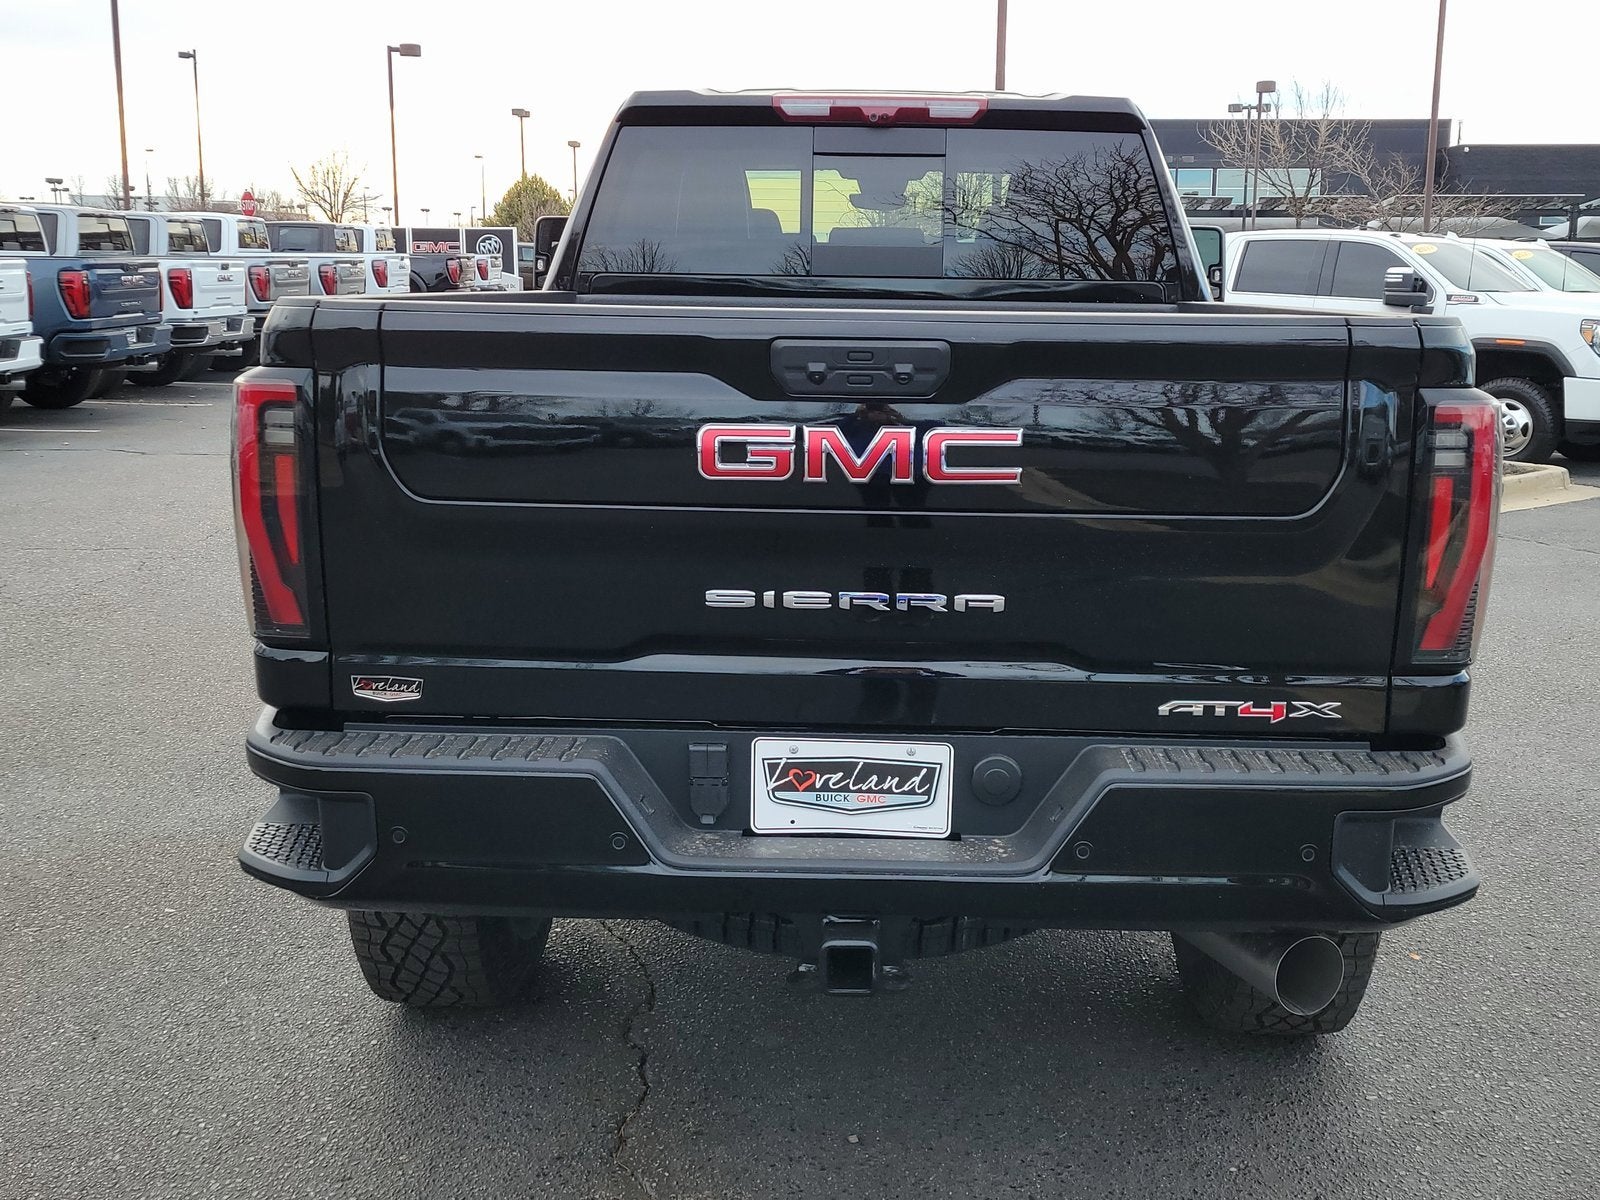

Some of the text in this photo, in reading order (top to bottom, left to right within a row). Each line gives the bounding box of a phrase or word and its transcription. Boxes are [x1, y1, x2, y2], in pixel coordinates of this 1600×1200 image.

[241, 200, 255, 211] STOP
[412, 241, 460, 254] GMC
[696, 423, 1024, 486] GMC
[704, 589, 1006, 614] SIERRA
[1157, 700, 1342, 724] AT4X
[815, 793, 887, 804] BUICK GMC
